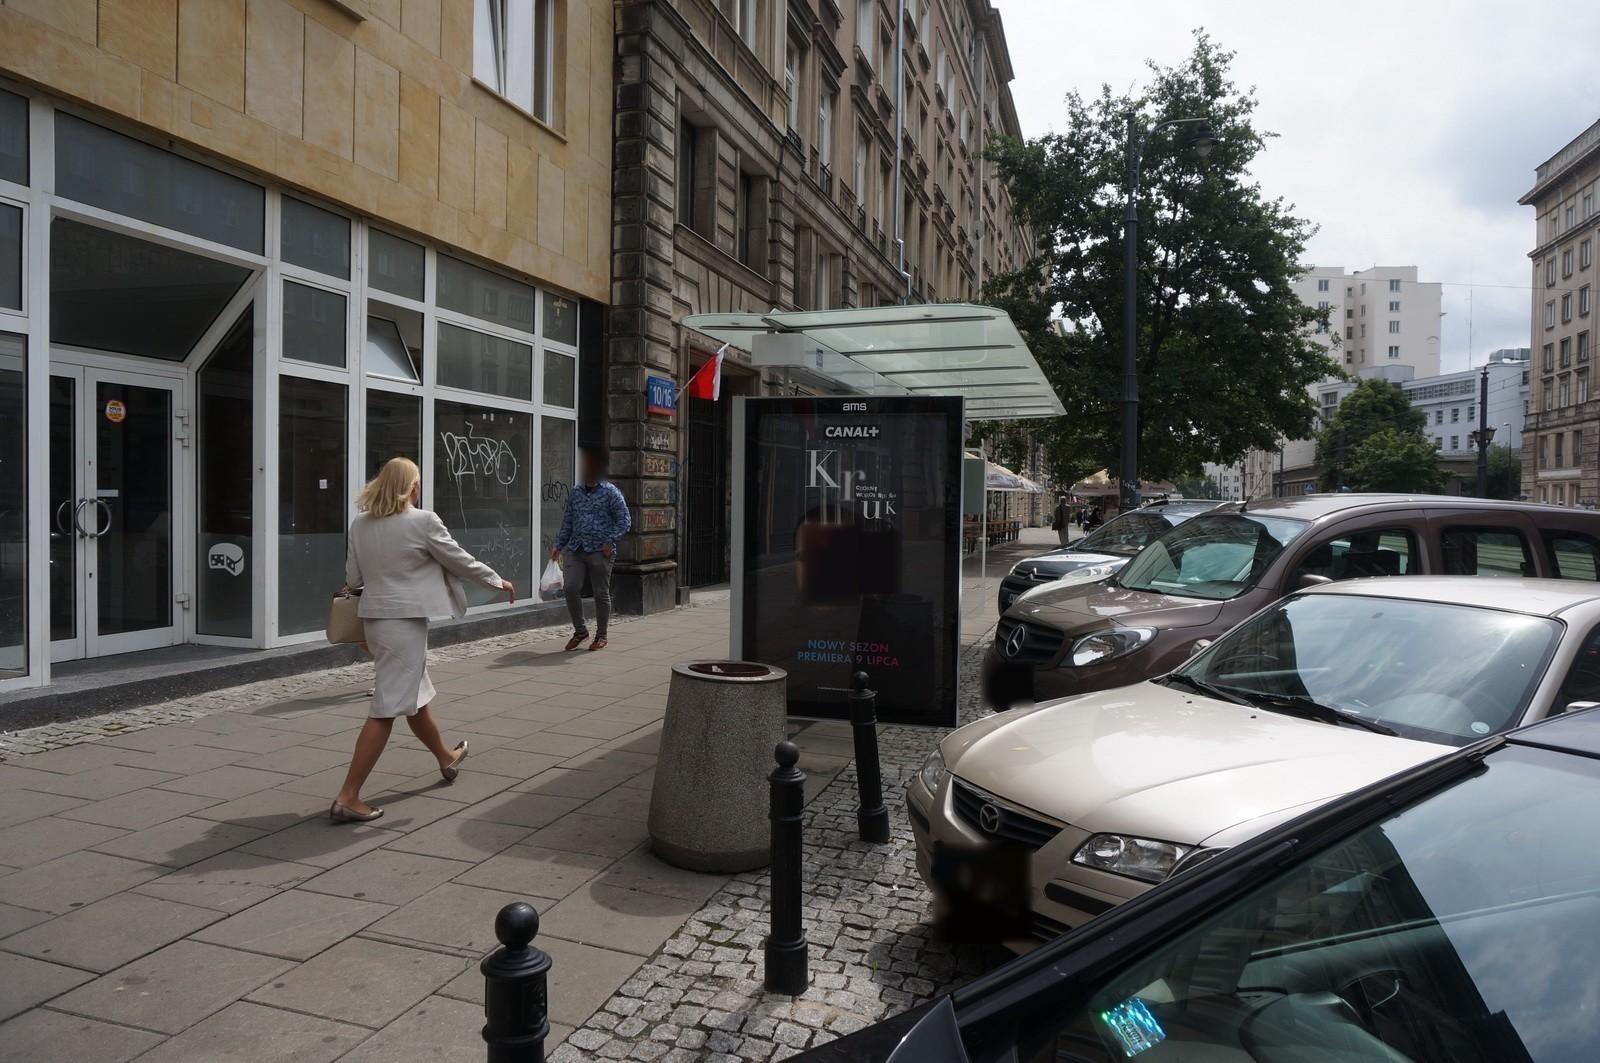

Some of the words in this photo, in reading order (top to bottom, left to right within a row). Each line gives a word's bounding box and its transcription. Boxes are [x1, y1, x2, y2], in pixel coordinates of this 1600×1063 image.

[653, 385, 672, 408] 10/16
[842, 402, 867, 411] ams
[825, 426, 880, 437] CANAL+
[807, 640, 846, 650] NOWY
[849, 642, 889, 653] SEZON
[798, 651, 853, 664] PREMIERA
[855, 654, 863, 665] 9
[867, 656, 900, 667] LIPCA
